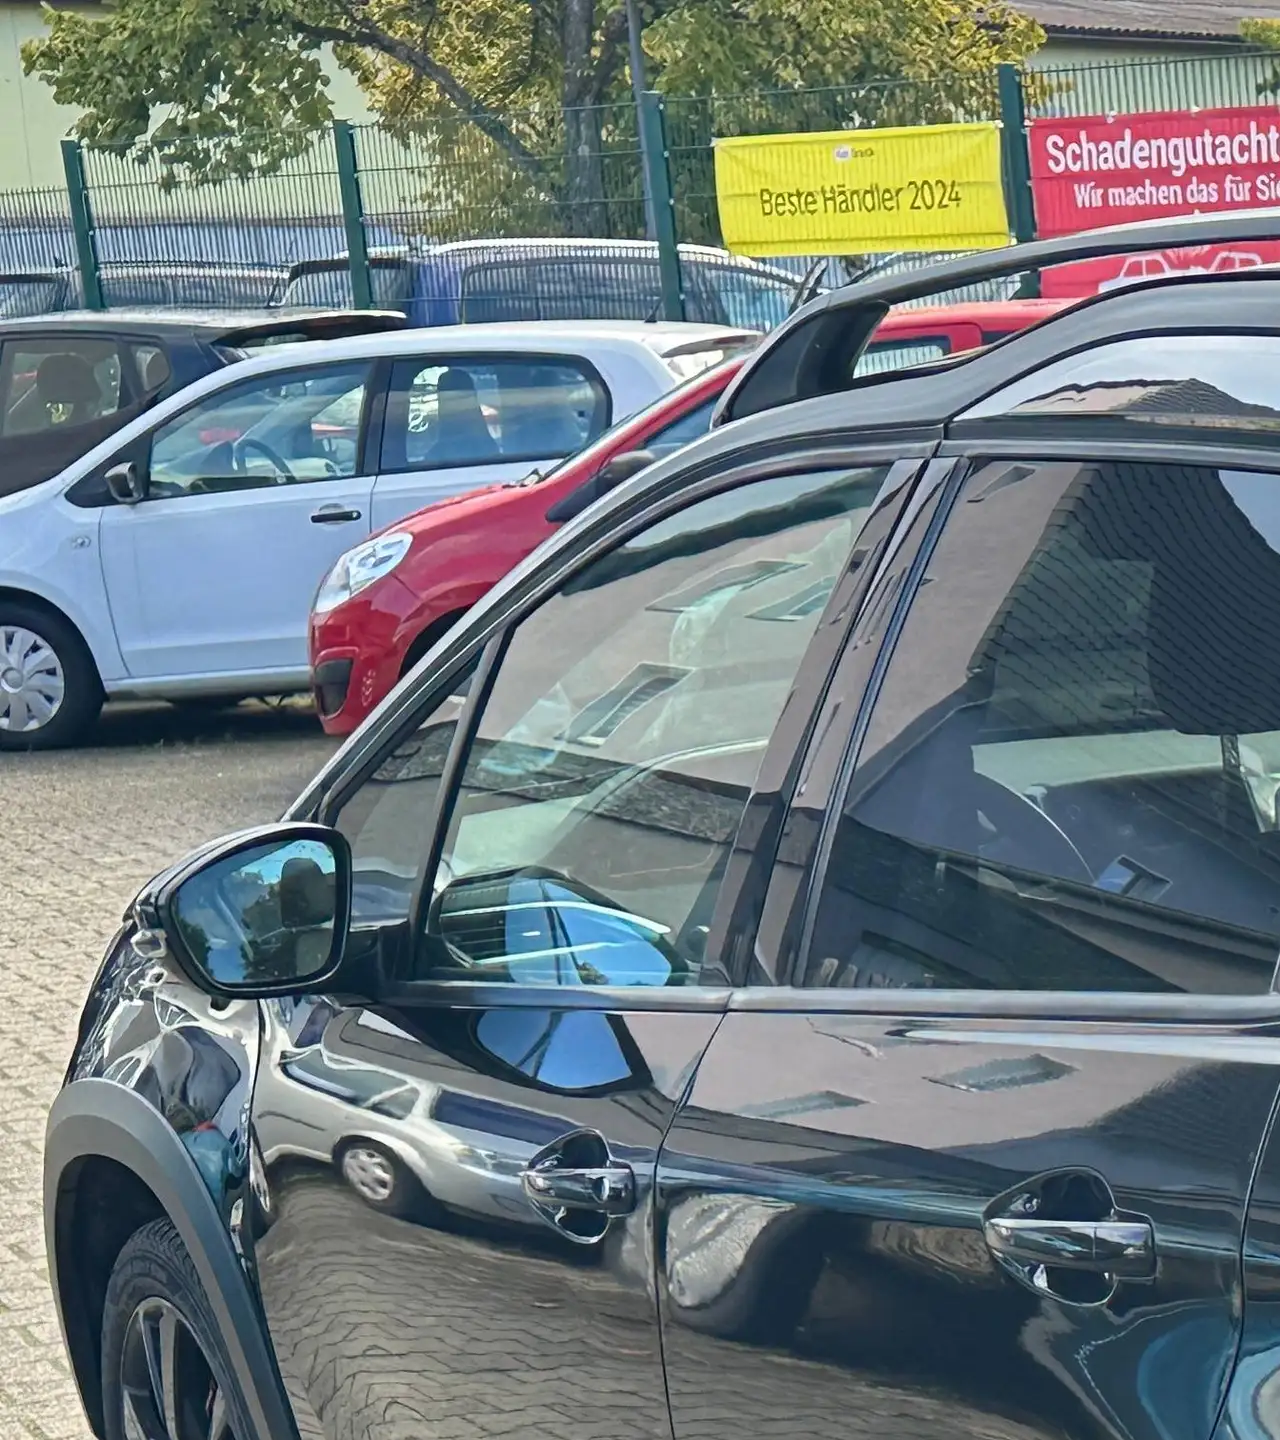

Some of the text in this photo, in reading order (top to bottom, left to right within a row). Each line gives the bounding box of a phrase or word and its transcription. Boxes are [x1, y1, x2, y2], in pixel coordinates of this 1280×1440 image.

[759, 179, 962, 217] Beste Händler 2024
[1074, 181, 1104, 208] Wir
[1108, 179, 1183, 206] machen
[1186, 176, 1219, 204] das
[1224, 174, 1251, 202] für
